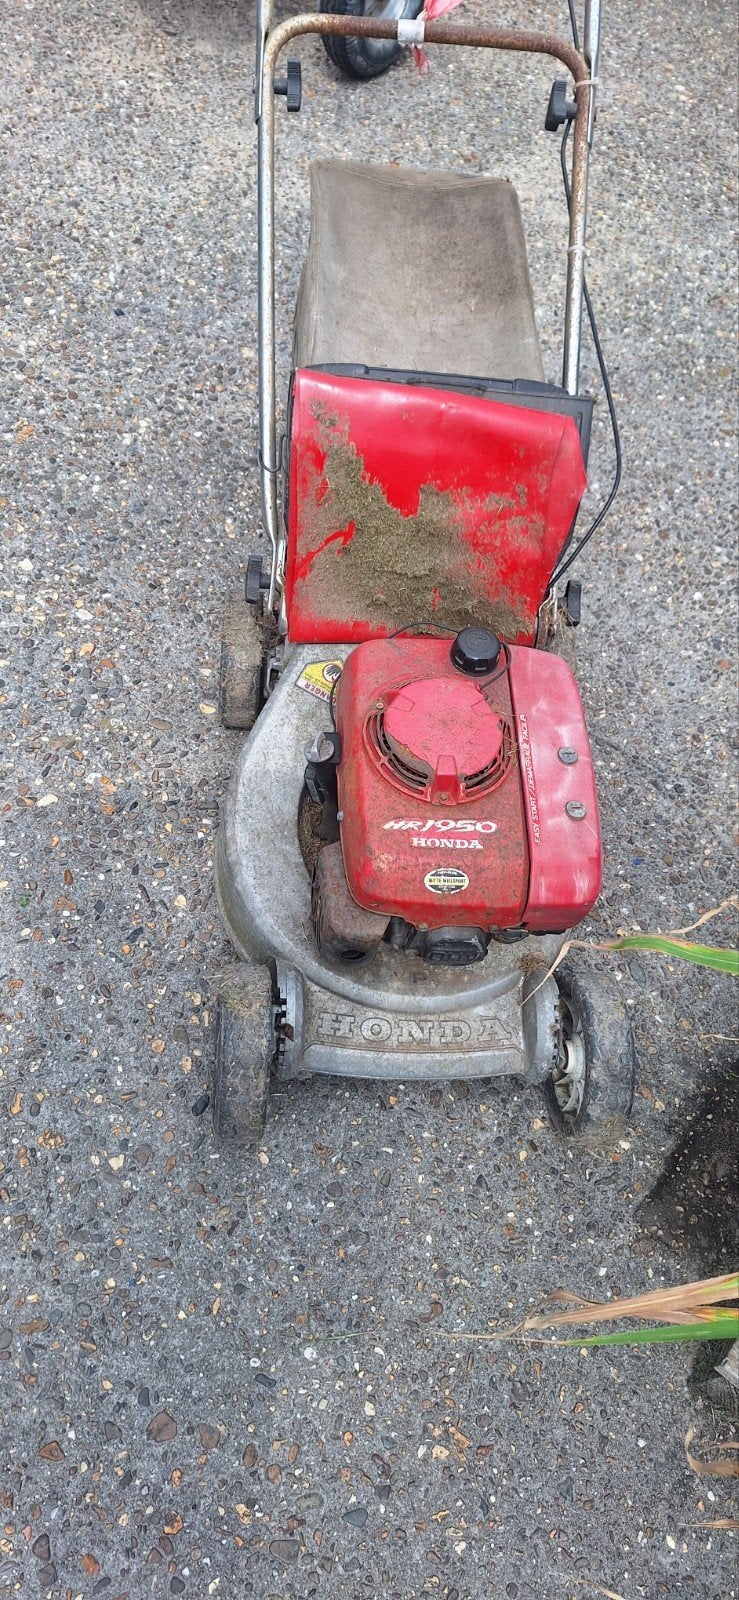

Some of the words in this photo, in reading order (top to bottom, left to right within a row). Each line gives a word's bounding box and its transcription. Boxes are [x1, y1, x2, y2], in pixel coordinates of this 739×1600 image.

[383, 819, 498, 833] HR1950
[532, 823, 541, 844] EASY
[411, 837, 484, 849] HONDA
[317, 1011, 513, 1043] HONDA
